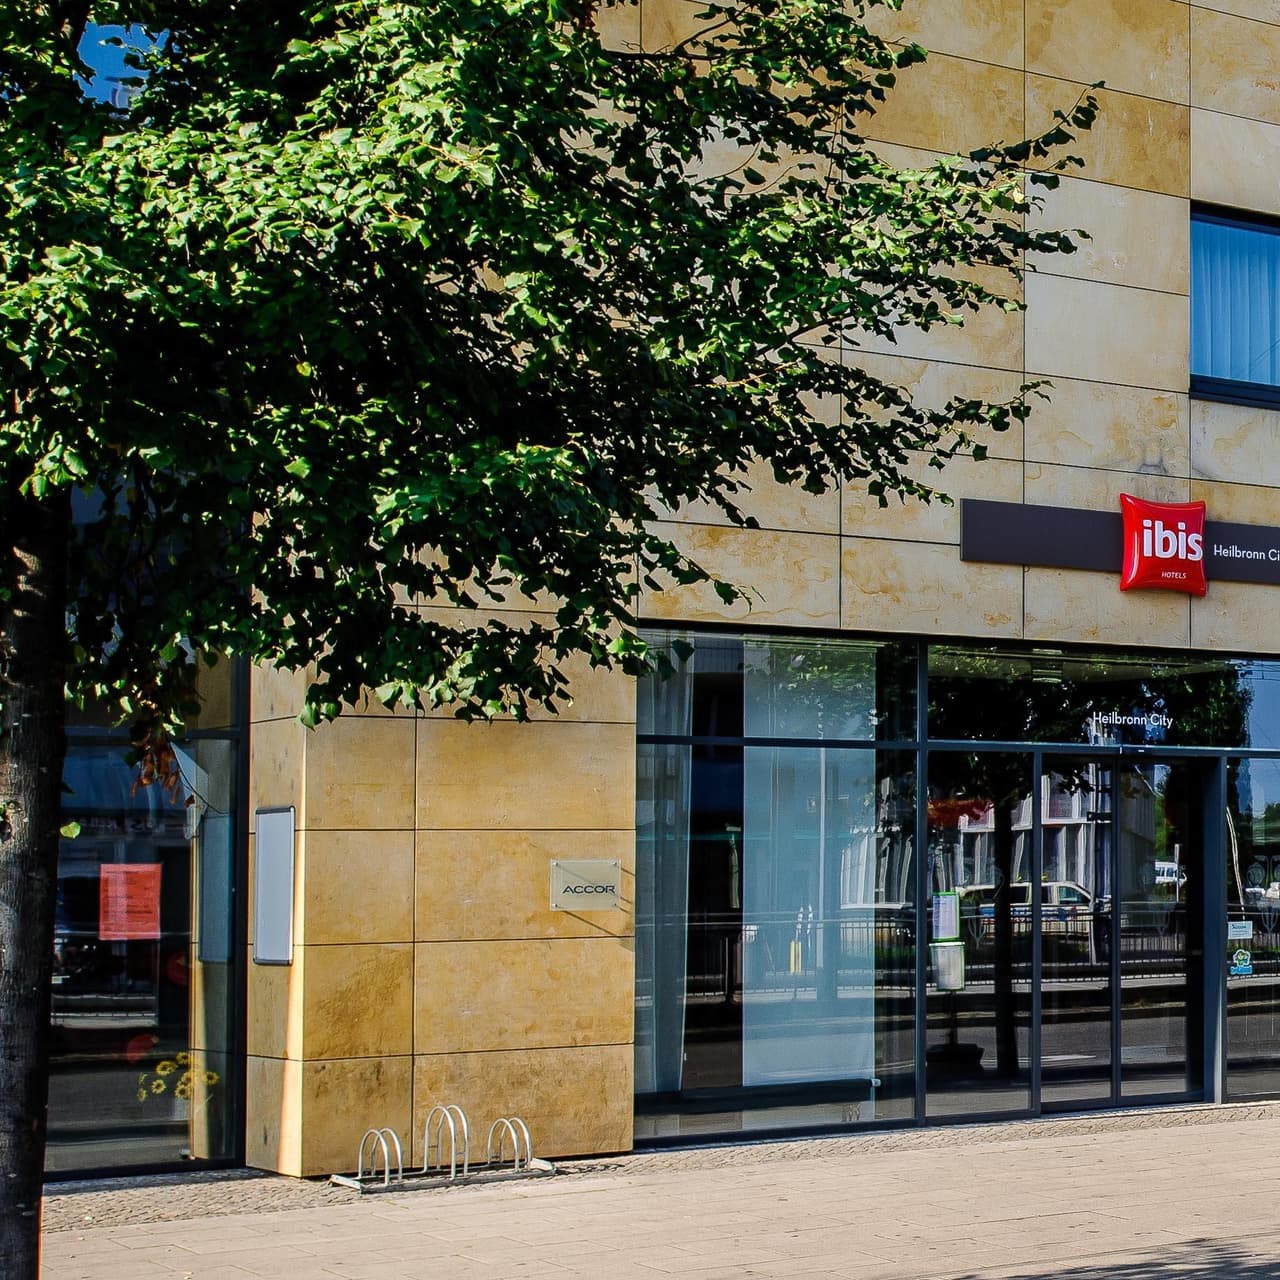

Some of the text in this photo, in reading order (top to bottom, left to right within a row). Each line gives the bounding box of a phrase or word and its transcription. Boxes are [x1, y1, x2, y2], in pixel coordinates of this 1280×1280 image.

[1143, 519, 1204, 562] ibis
[1213, 544, 1266, 560] Heilbronn
[1161, 571, 1187, 580] HOTELS
[1093, 711, 1174, 729] Heilbronn City
[562, 885, 616, 894] ACCOR
